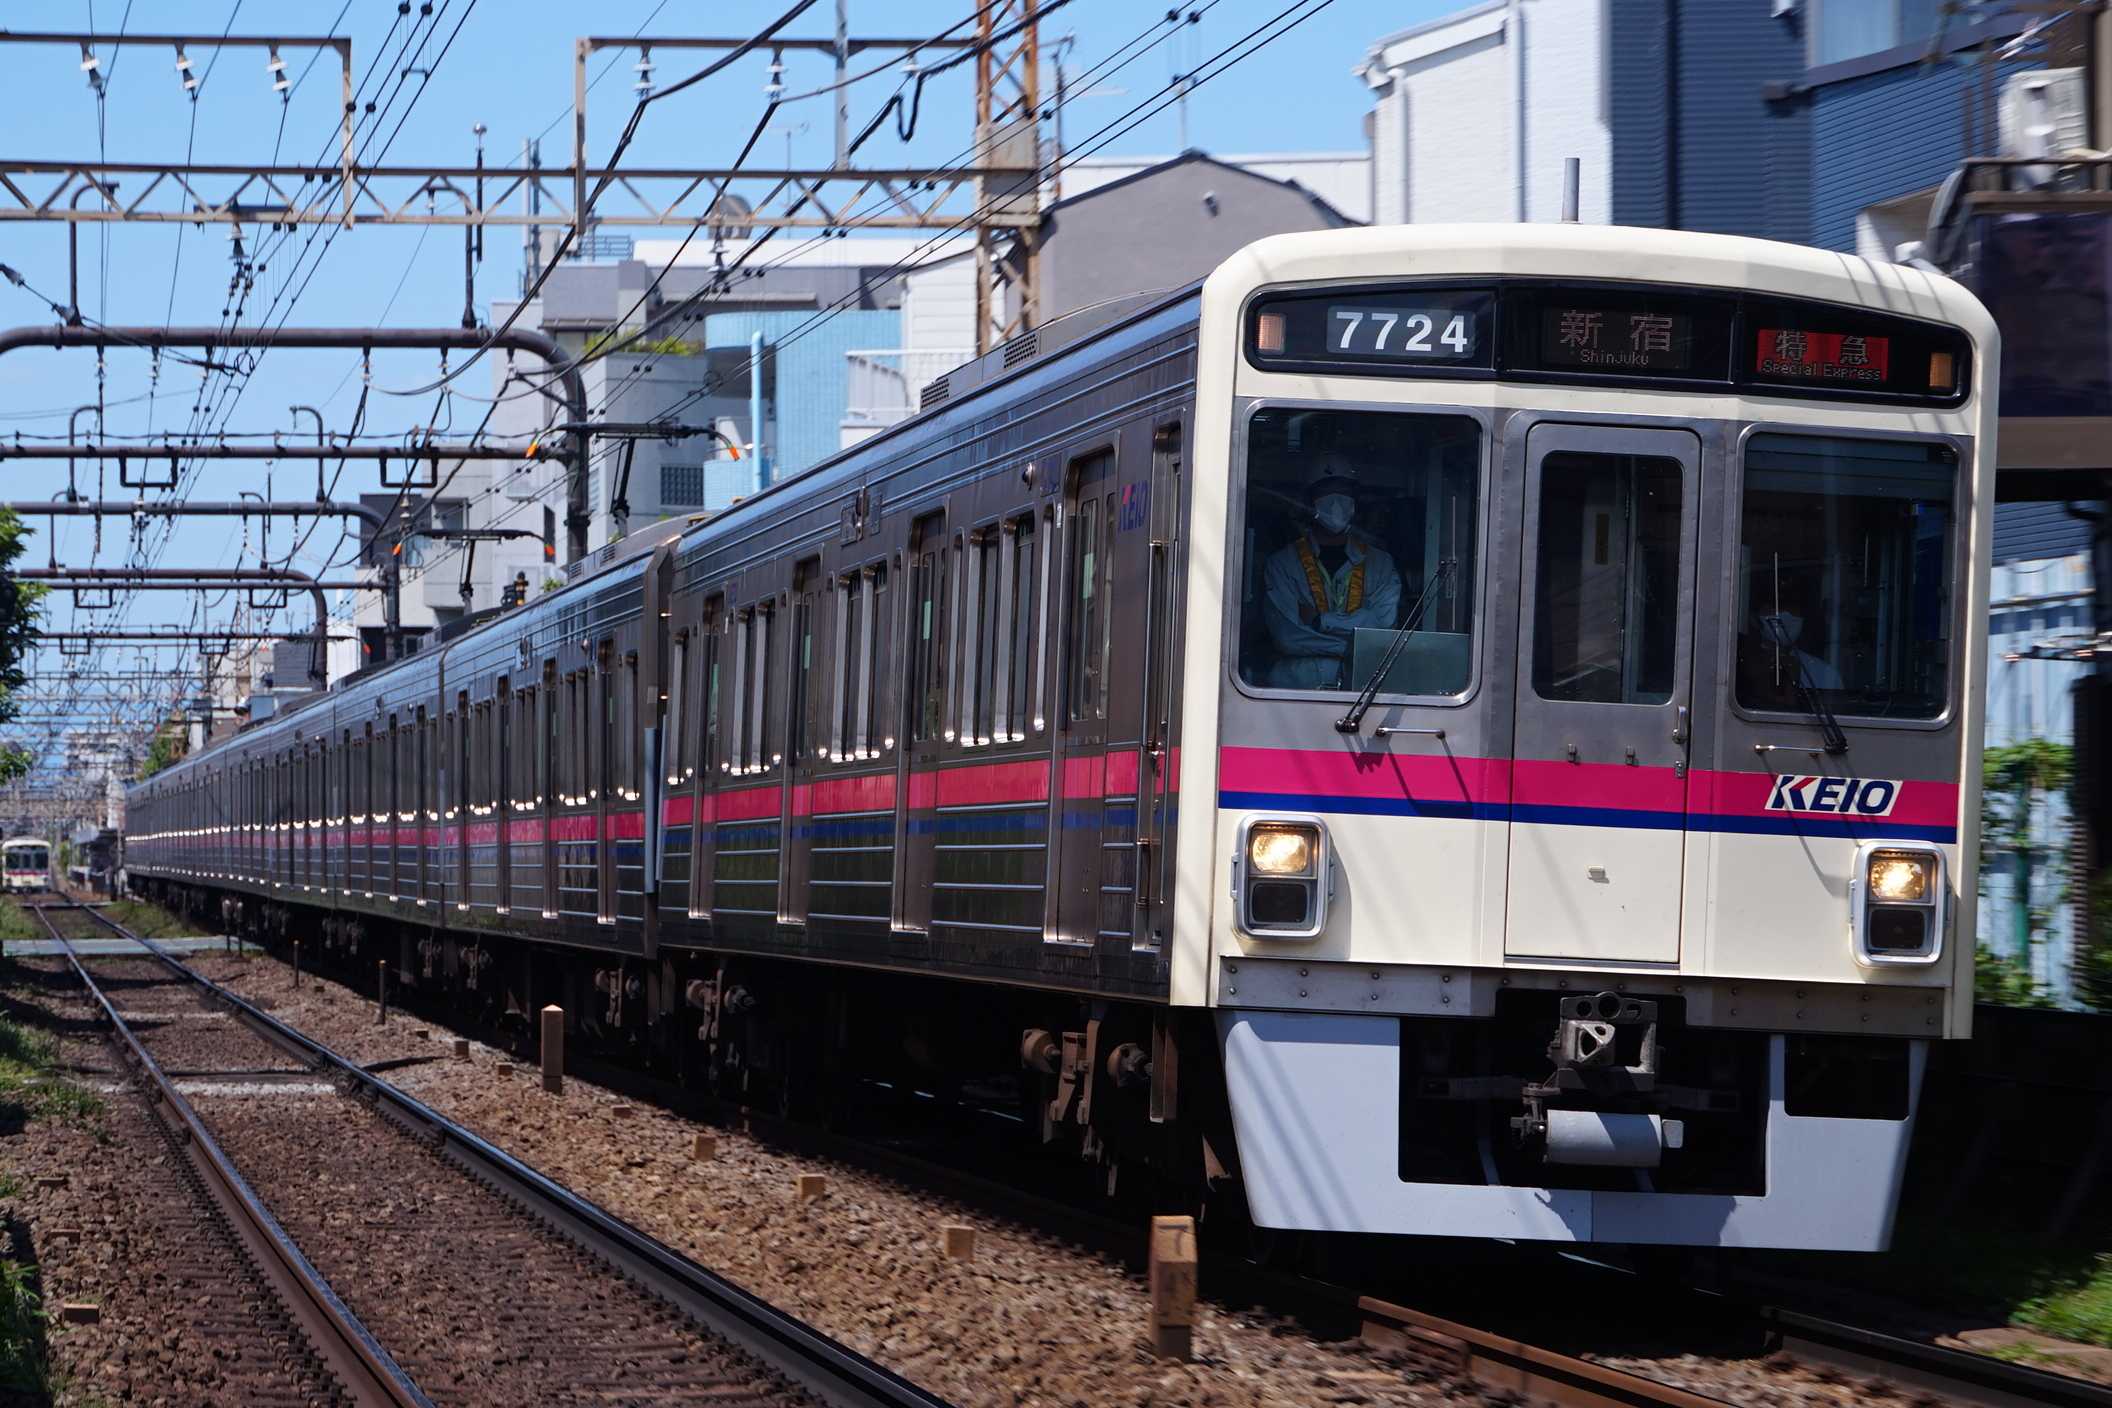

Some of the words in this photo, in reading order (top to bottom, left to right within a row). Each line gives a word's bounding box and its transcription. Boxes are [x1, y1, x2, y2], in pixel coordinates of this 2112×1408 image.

[1336, 311, 1468, 353] 7724
[1560, 310, 1672, 351] 新宿
[1776, 329, 1869, 365] 特急
[1763, 359, 1817, 376] Special
[1823, 363, 1881, 381] Express
[1771, 775, 1895, 814] KEIO
